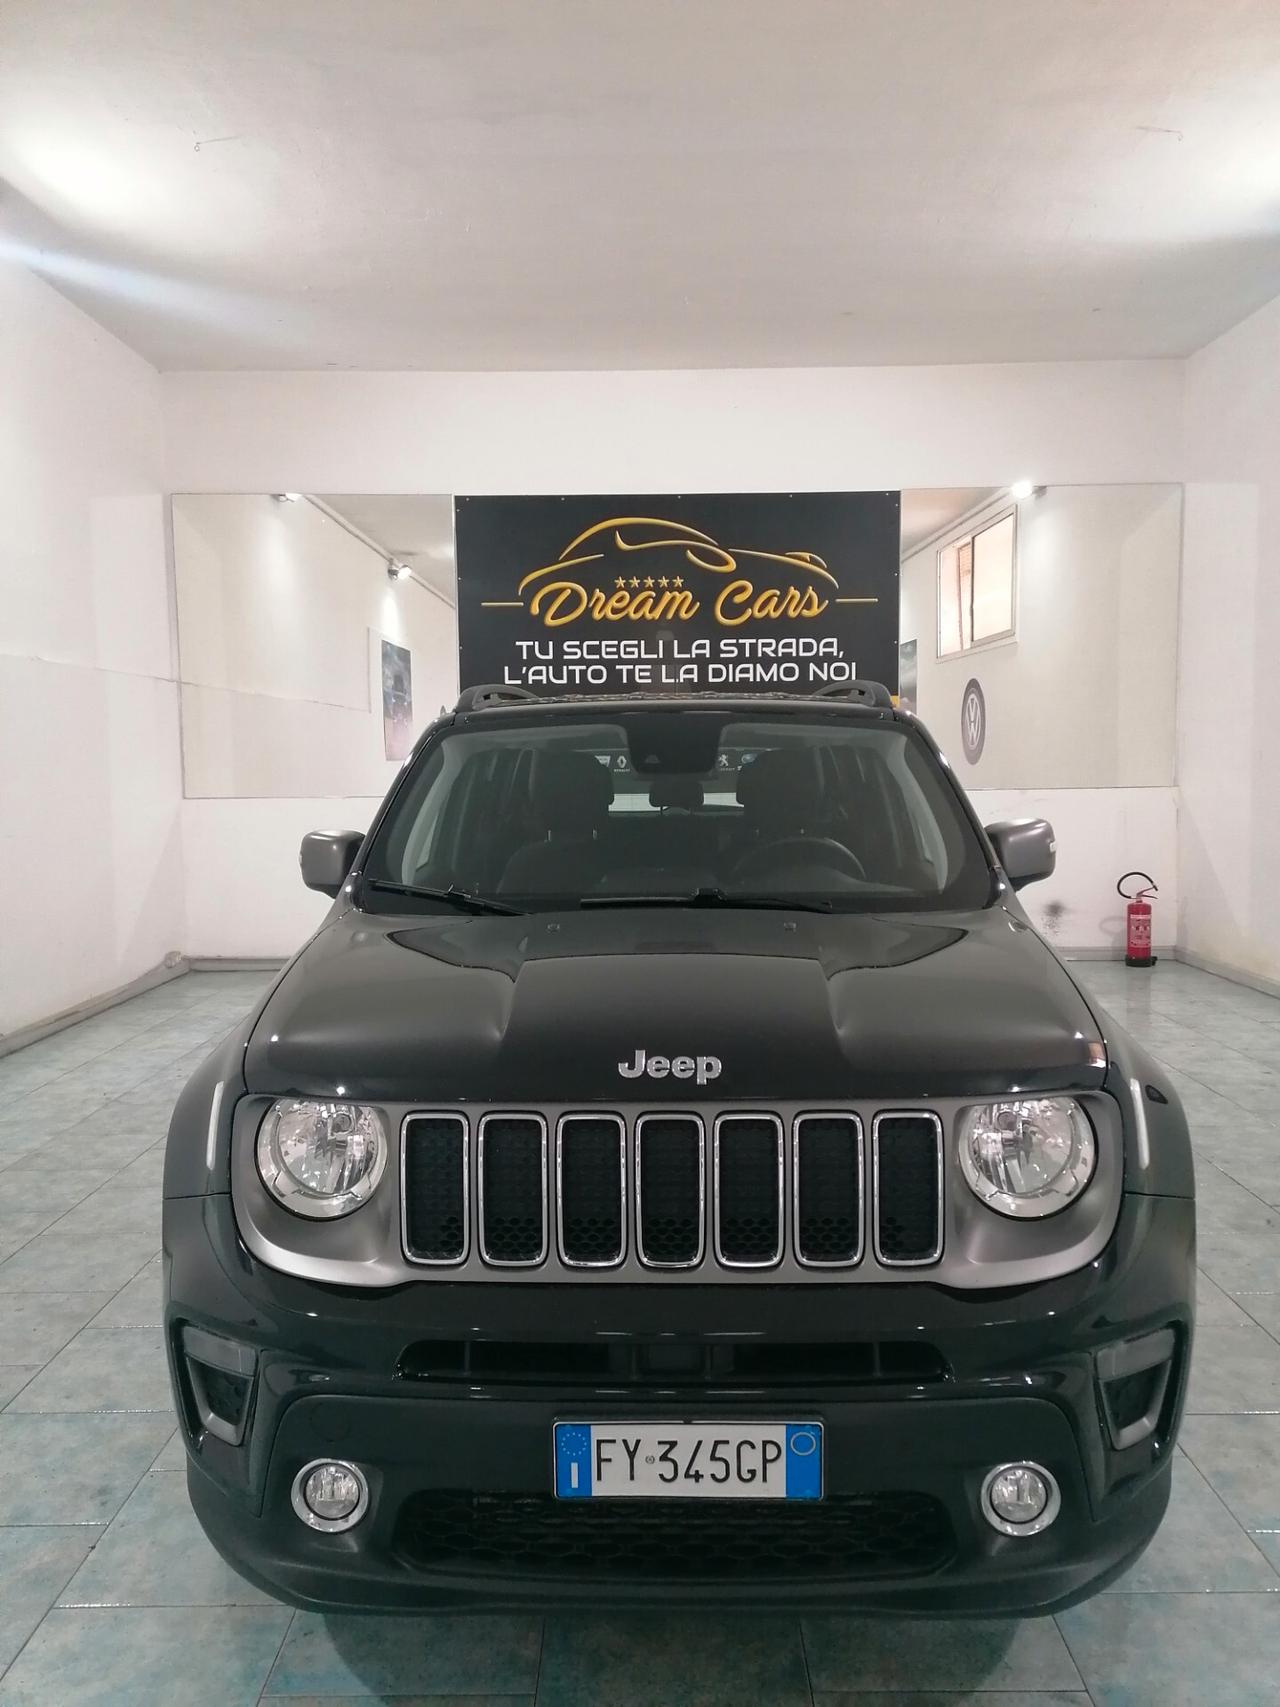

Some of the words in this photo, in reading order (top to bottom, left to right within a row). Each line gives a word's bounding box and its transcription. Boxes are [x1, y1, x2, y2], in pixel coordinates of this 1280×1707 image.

[531, 582, 700, 626] Dream
[715, 581, 829, 625] Cars
[516, 641, 553, 659] TU
[563, 640, 663, 659] SCEGLI
[674, 640, 710, 658] LA
[720, 638, 844, 659] STRADA,
[504, 665, 607, 686] L'AUTO
[616, 665, 651, 683] TE
[662, 665, 697, 683] LA
[709, 663, 799, 682] DIAMO
[810, 662, 856, 681] NOI
[618, 1050, 722, 1085] Jeep
[597, 1439, 641, 1481] FY
[658, 1440, 781, 1483] 345GP
